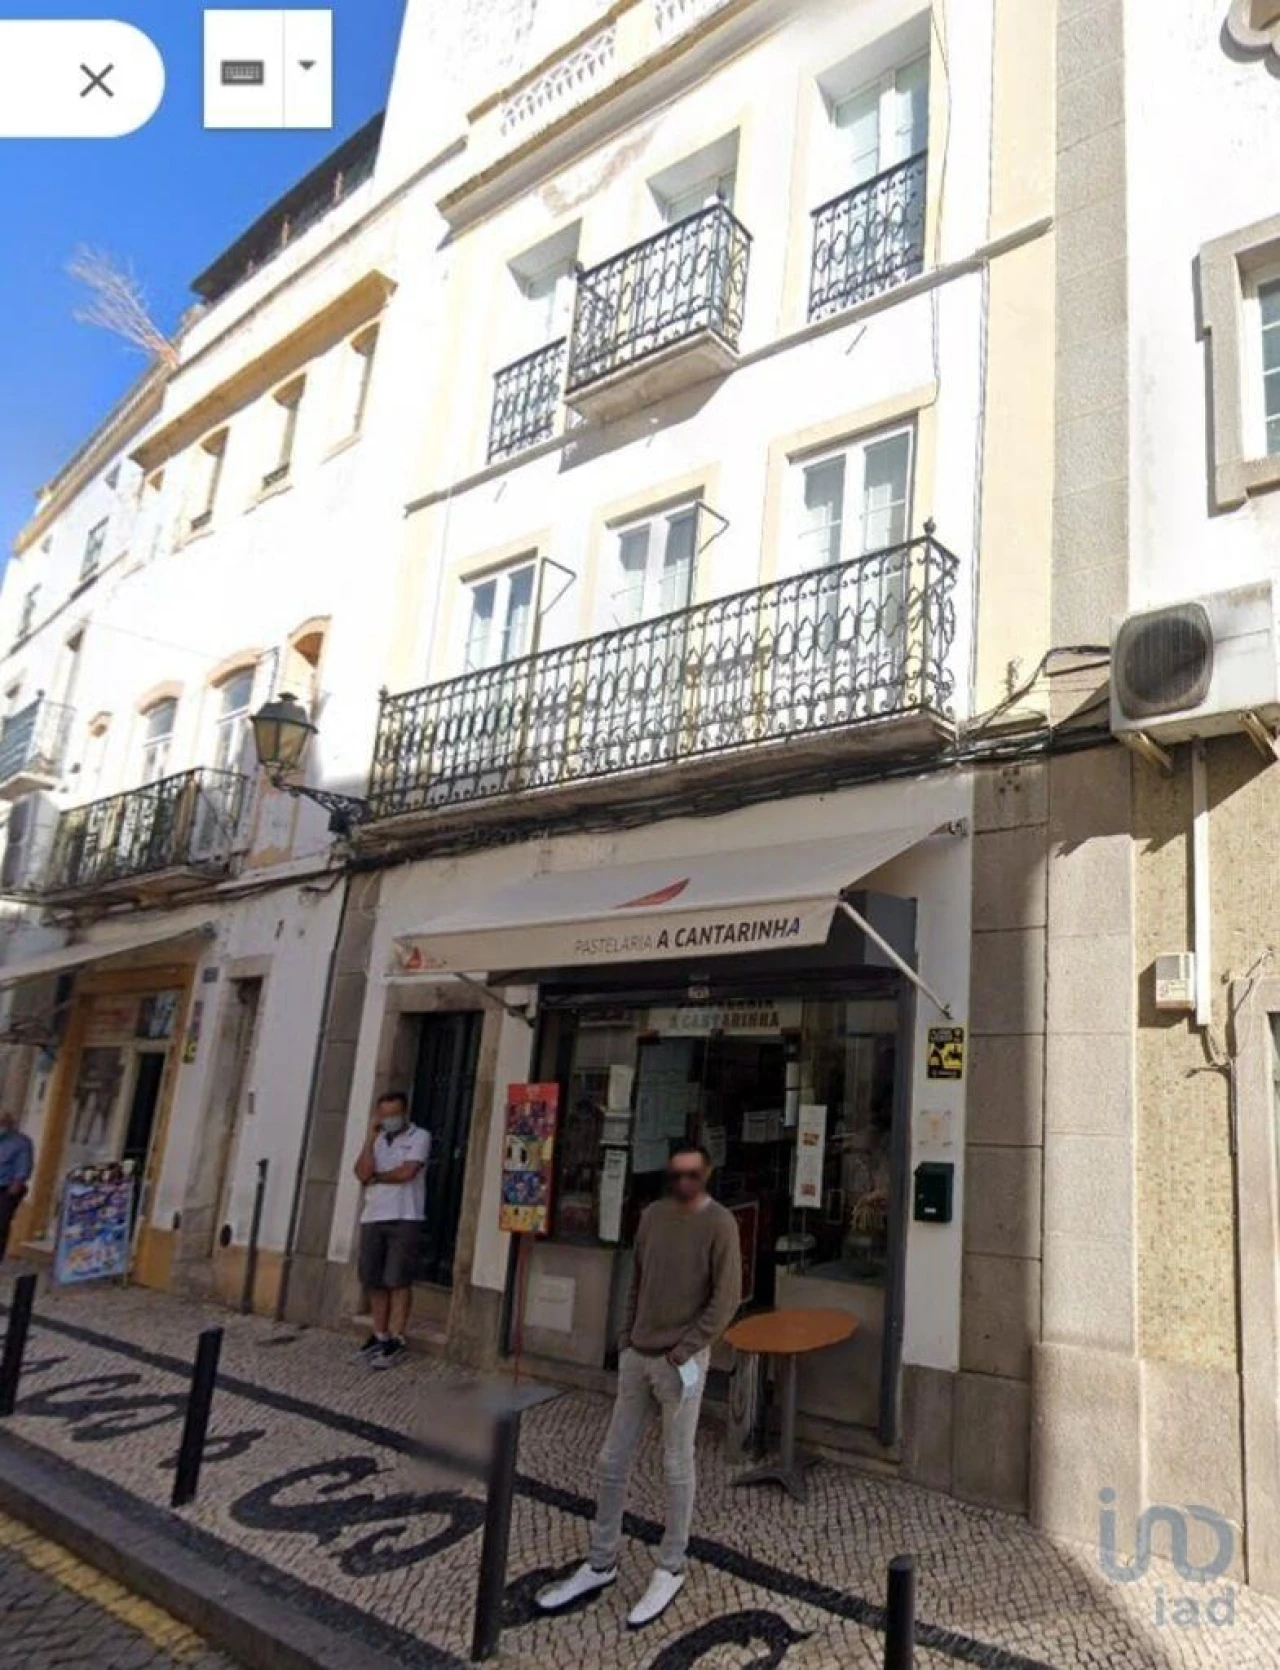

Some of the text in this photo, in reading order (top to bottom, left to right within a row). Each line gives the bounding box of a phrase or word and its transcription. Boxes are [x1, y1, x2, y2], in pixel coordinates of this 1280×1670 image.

[574, 916, 801, 955] PASTELARIA A CANTARINHA
